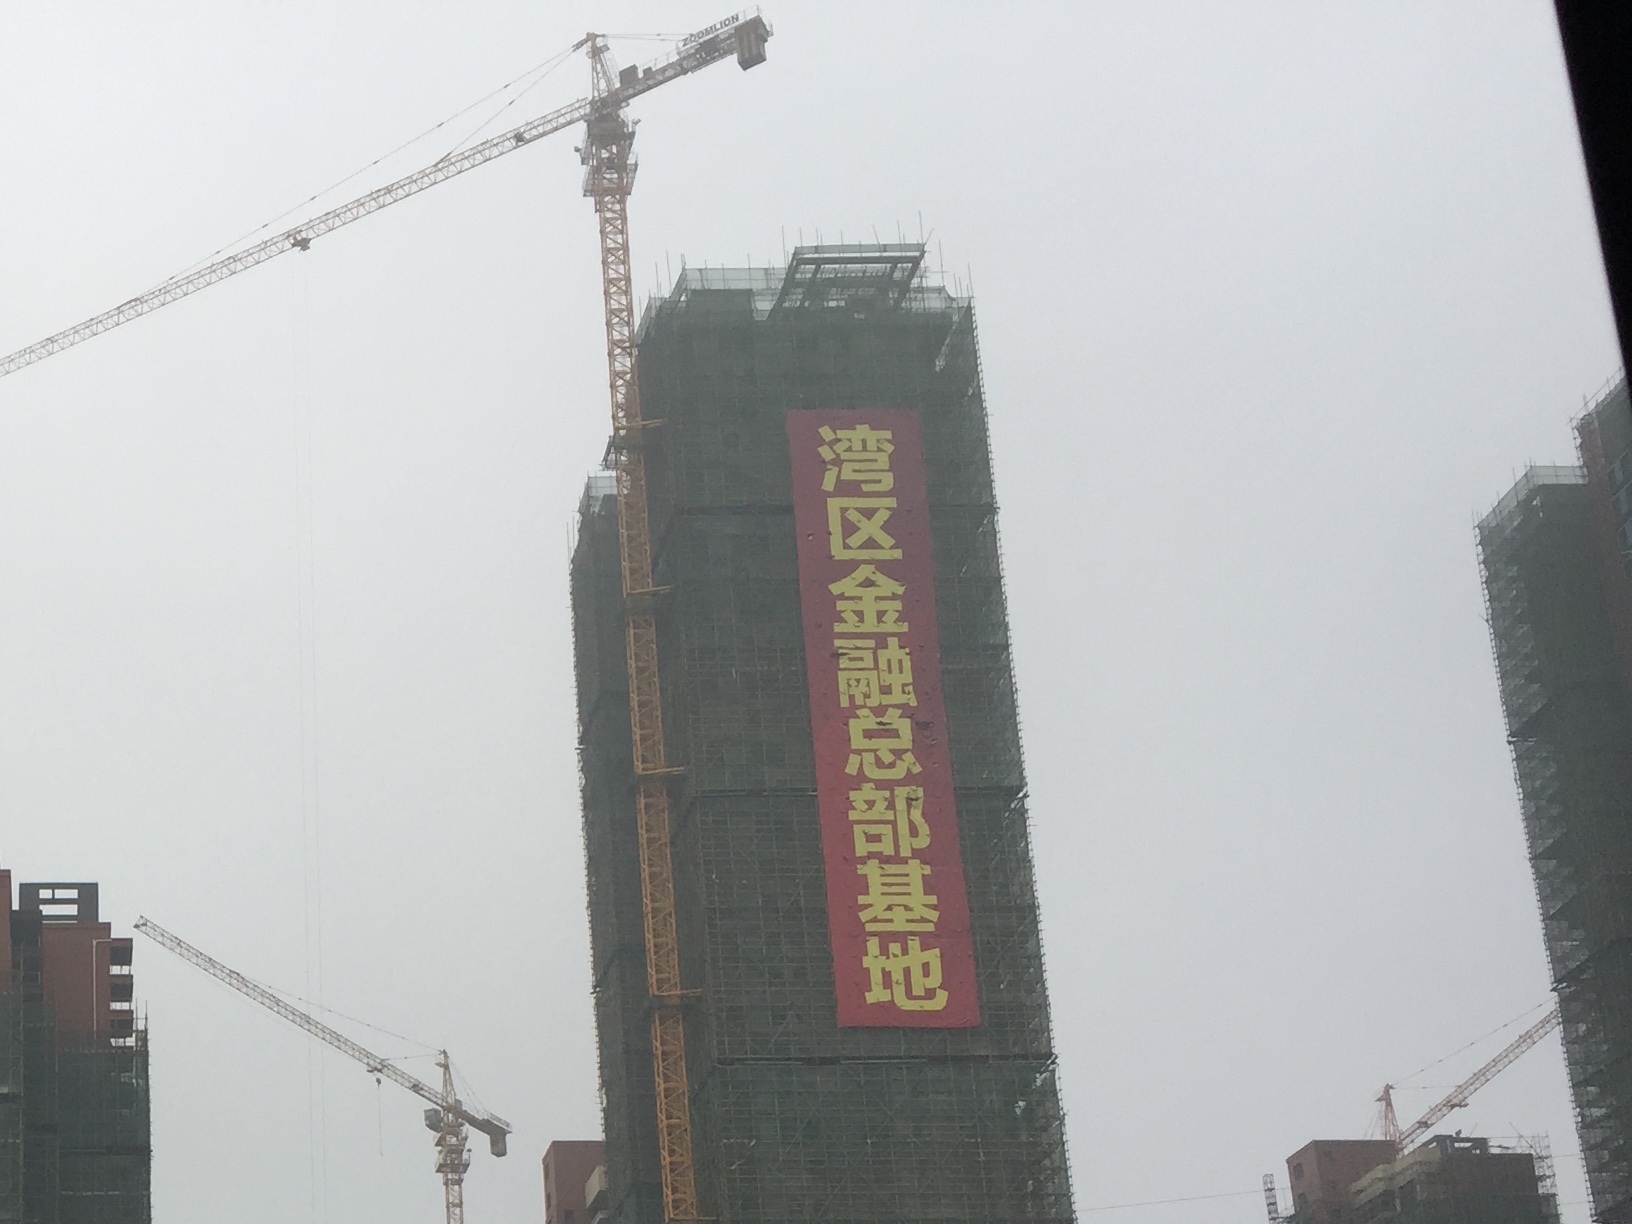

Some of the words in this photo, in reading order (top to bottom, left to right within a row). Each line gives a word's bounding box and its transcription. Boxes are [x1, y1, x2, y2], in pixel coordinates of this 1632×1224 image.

[681, 13, 739, 47] ZOOMLION
[817, 424, 948, 1011] 湾区金融总部基地
